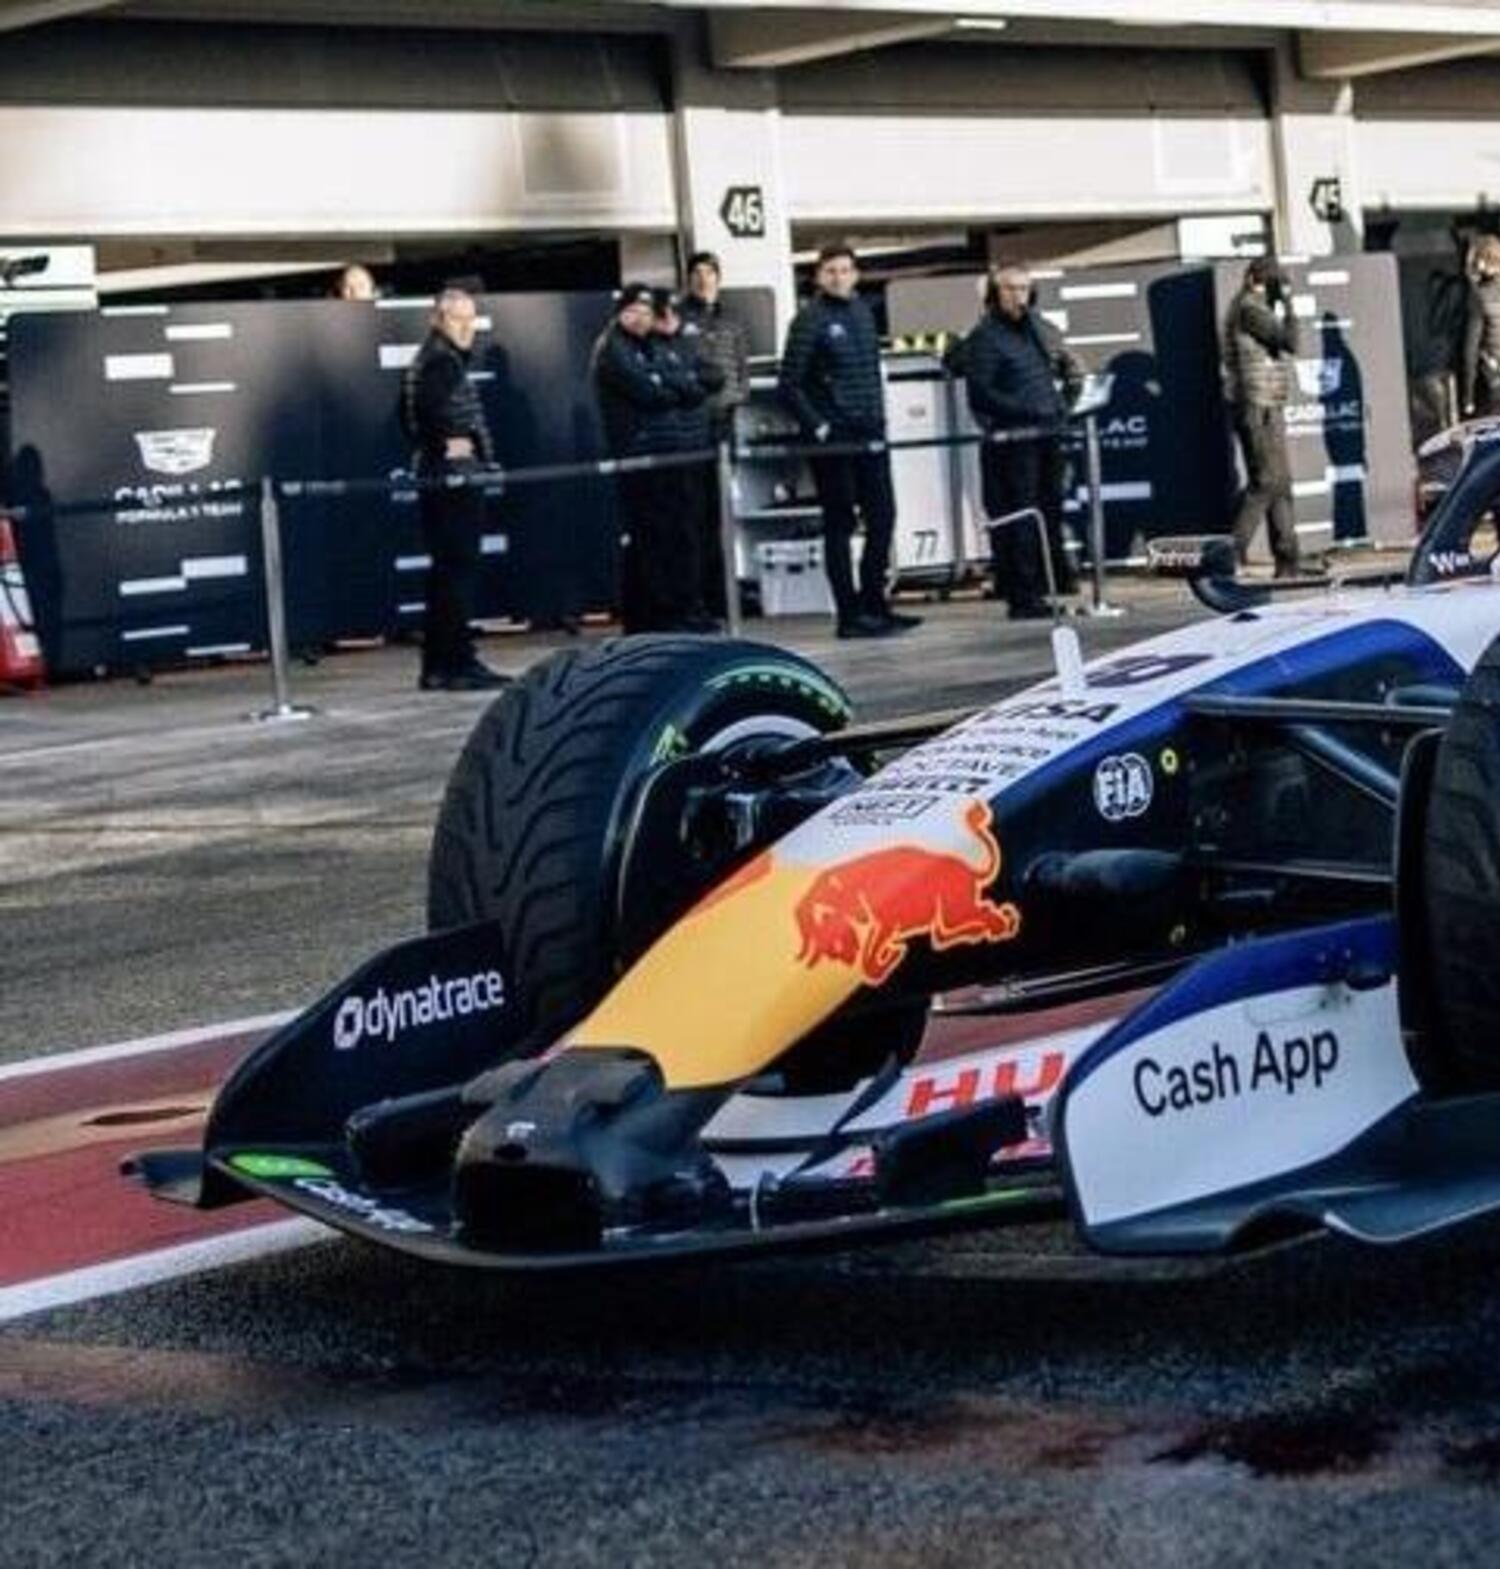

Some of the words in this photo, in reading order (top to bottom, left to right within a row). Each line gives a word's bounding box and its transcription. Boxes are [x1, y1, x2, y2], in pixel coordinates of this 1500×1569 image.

[728, 192, 762, 231] 46
[913, 529, 938, 560] 77
[365, 969, 505, 1042] dynatrace
[1133, 1042, 1241, 1117] Cash
[1251, 1029, 1339, 1096] App
